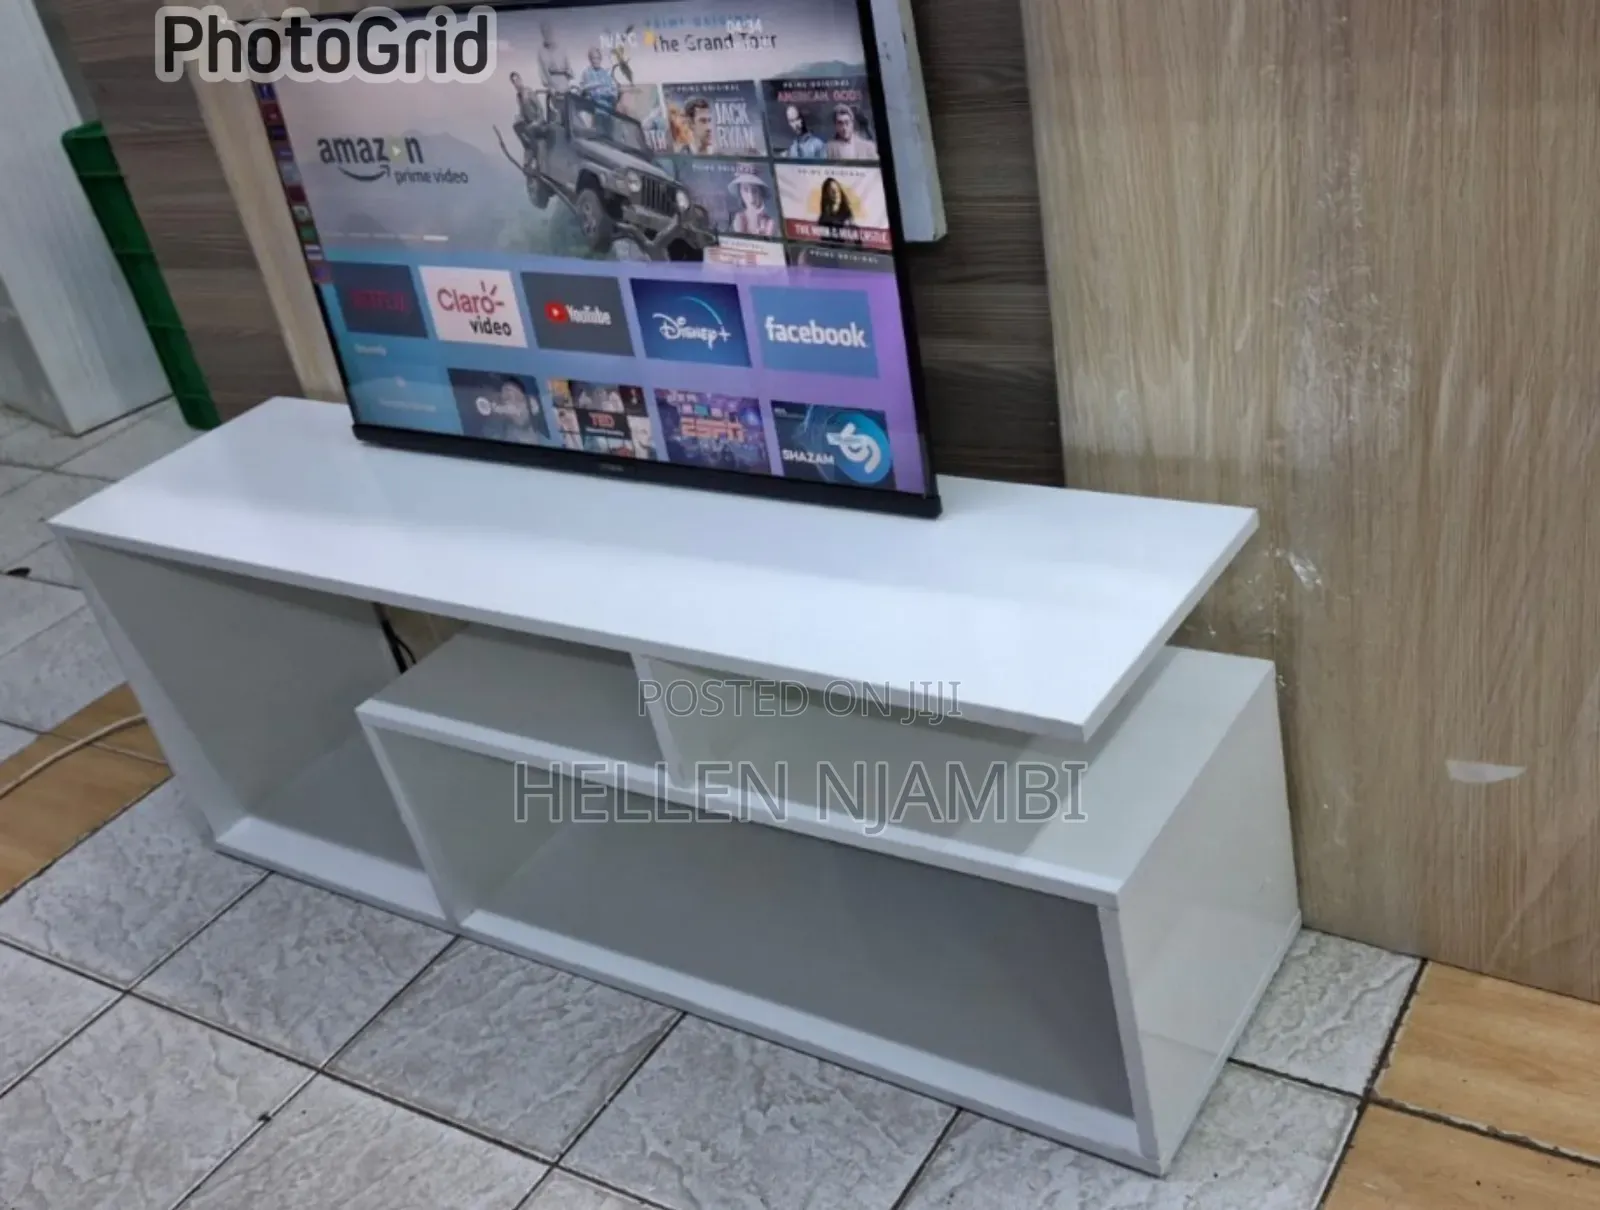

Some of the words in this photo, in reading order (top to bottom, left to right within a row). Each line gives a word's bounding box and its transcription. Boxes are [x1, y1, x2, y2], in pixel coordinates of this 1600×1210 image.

[684, 32, 734, 52] Grand
[395, 167, 432, 185] prime
[433, 166, 469, 184] video
[437, 286, 496, 315] Claro
[566, 304, 612, 326] YouTube
[469, 316, 512, 337] video
[764, 314, 868, 349] facebook
[588, 412, 616, 429] TED
[680, 416, 745, 443] ESPN
[782, 449, 836, 465] SHAZAM
